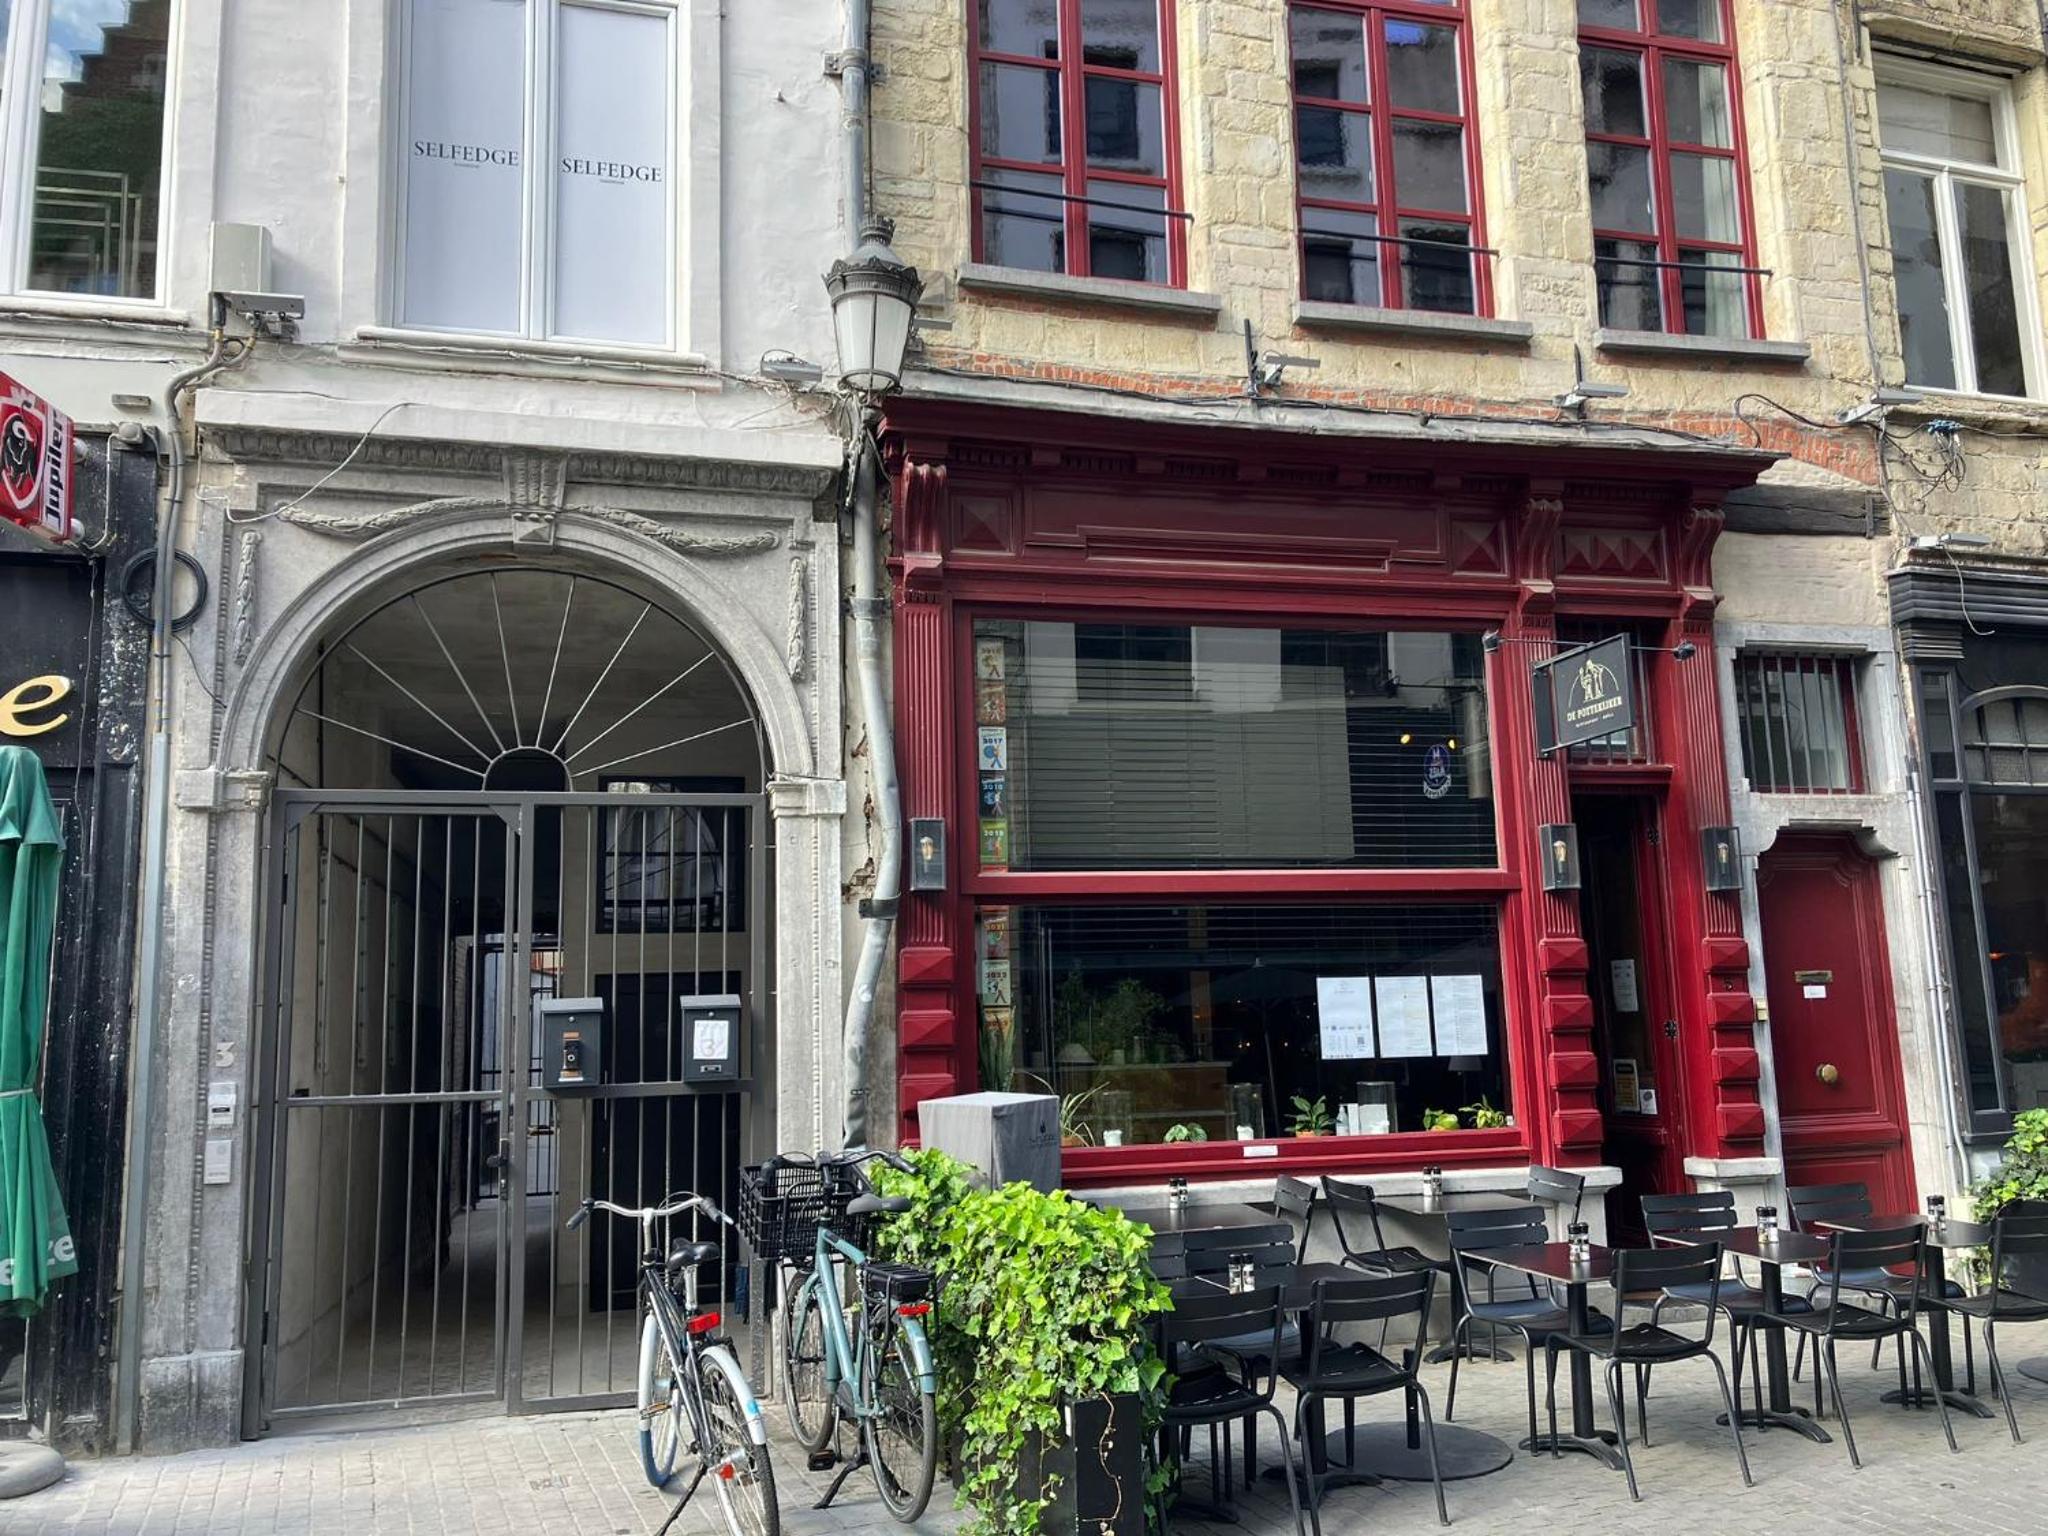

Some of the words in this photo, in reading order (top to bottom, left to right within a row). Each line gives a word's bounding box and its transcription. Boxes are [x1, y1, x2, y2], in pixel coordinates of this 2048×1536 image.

[414, 140, 519, 167] SELFEDGE
[561, 157, 663, 183] SELFEDGE
[44, 408, 65, 532] Jupiler
[1567, 711, 1577, 722] DE
[215, 1042, 235, 1067] 3
